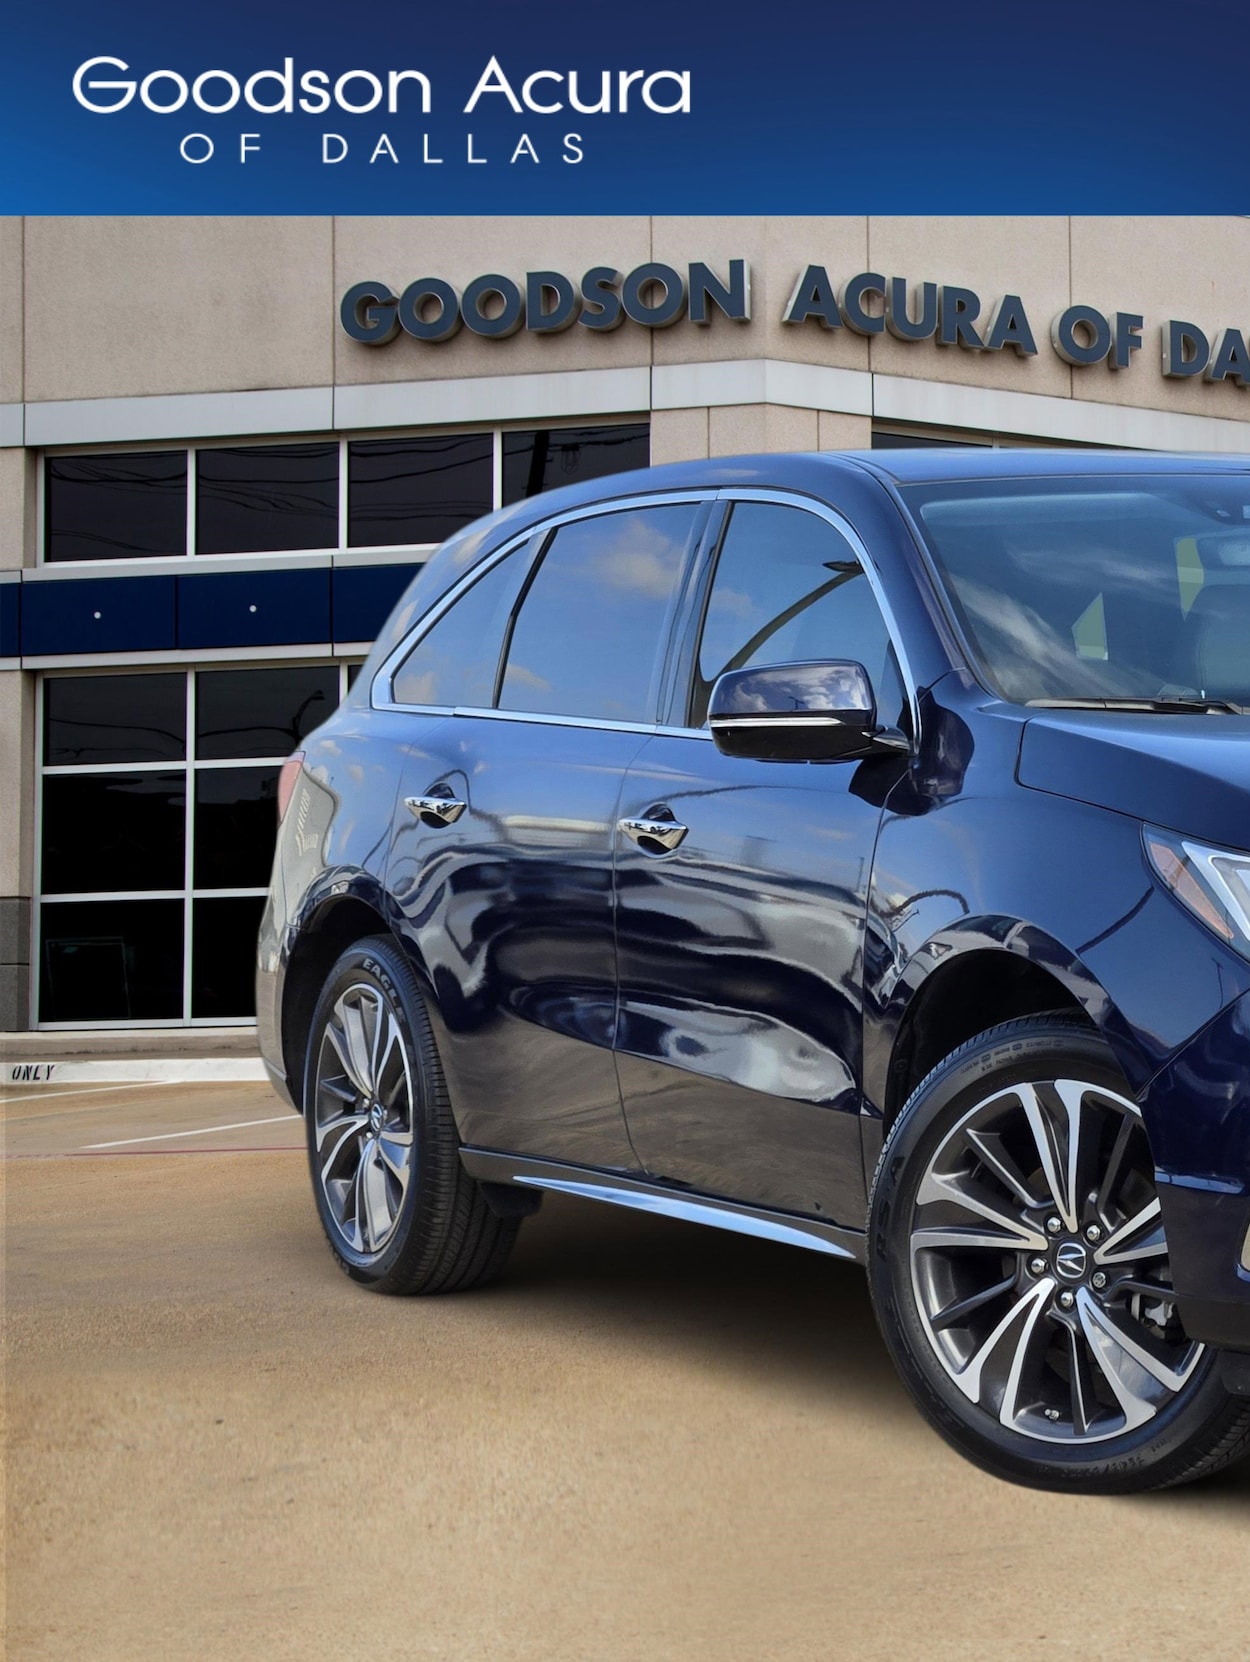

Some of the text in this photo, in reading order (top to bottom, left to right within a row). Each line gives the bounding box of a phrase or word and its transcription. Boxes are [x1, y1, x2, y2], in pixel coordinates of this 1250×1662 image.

[340, 259, 751, 344] GOODSON
[782, 264, 1038, 356] ACURA
[1051, 304, 1143, 369] OF
[12, 1064, 54, 1080] ONLY
